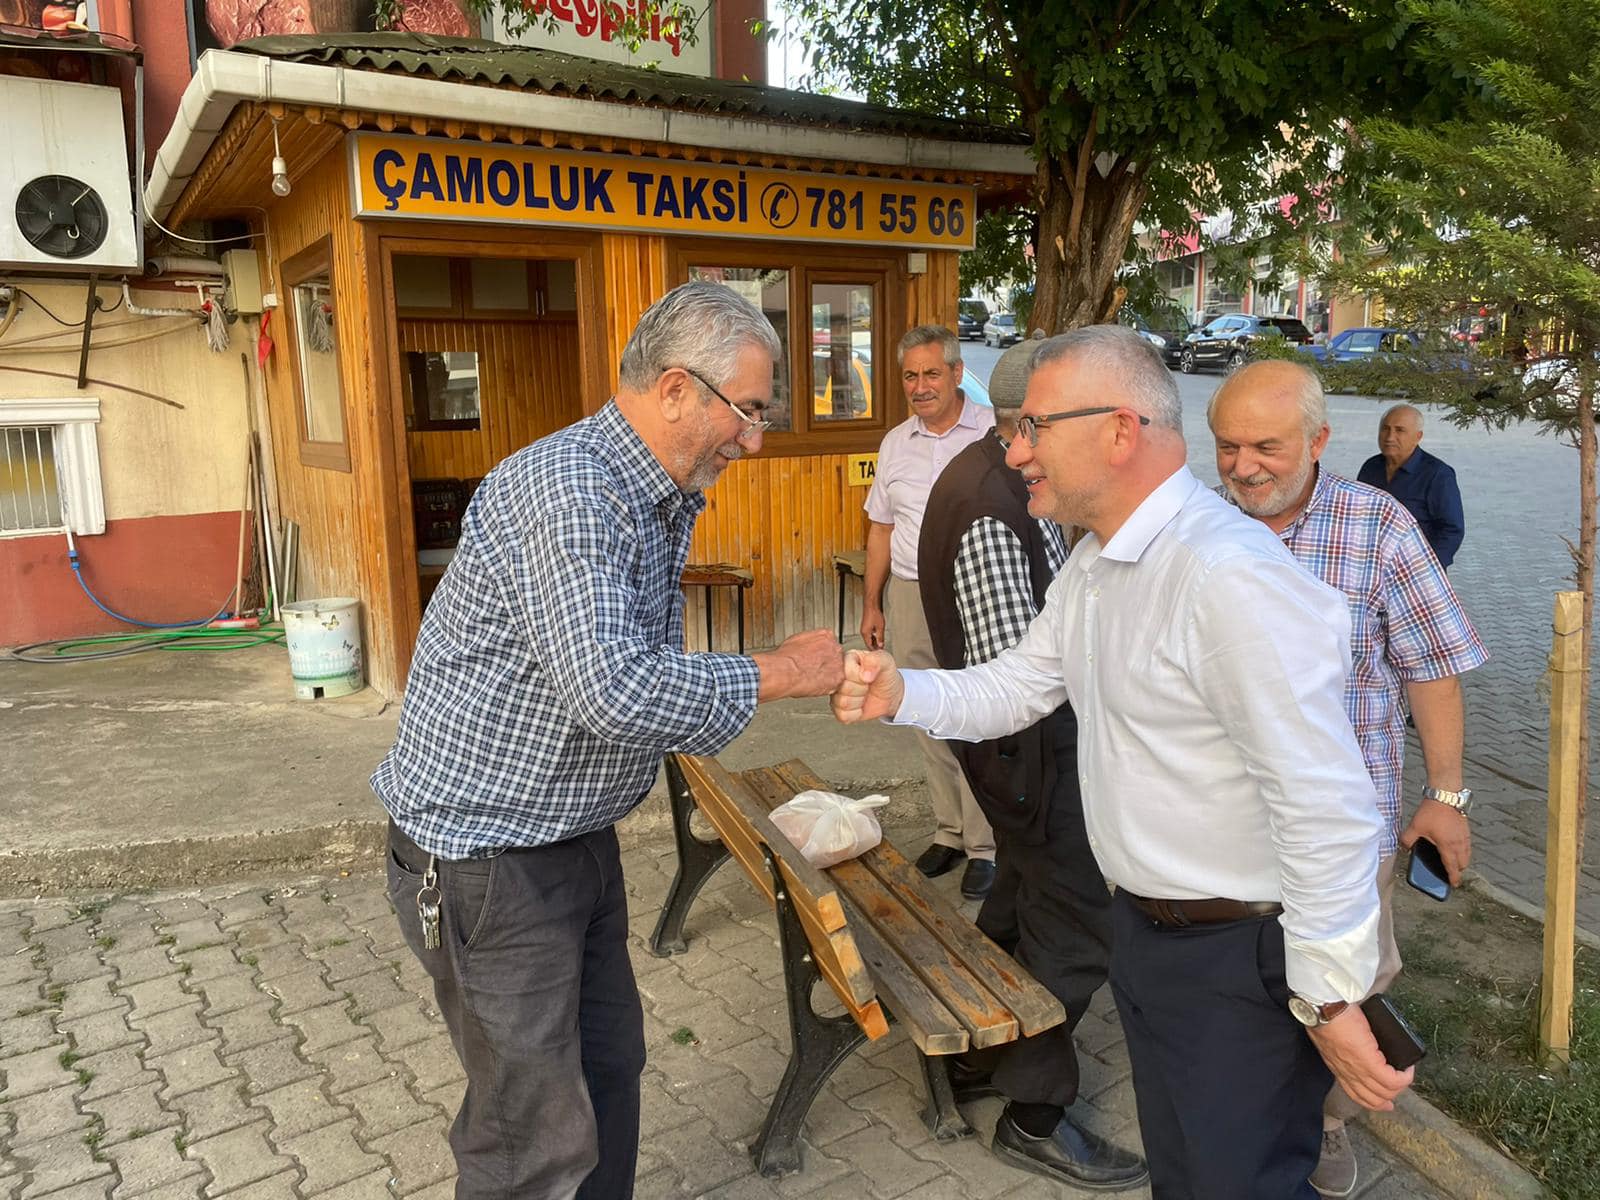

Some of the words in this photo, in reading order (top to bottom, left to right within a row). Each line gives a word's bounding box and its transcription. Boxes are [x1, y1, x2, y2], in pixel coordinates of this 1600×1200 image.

[373, 149, 615, 213] ÇAMOLUK
[627, 171, 748, 223] TAKSİ
[806, 187, 864, 231] 781
[879, 193, 917, 234] 55
[928, 197, 965, 237] 66
[858, 460, 877, 479] TA
